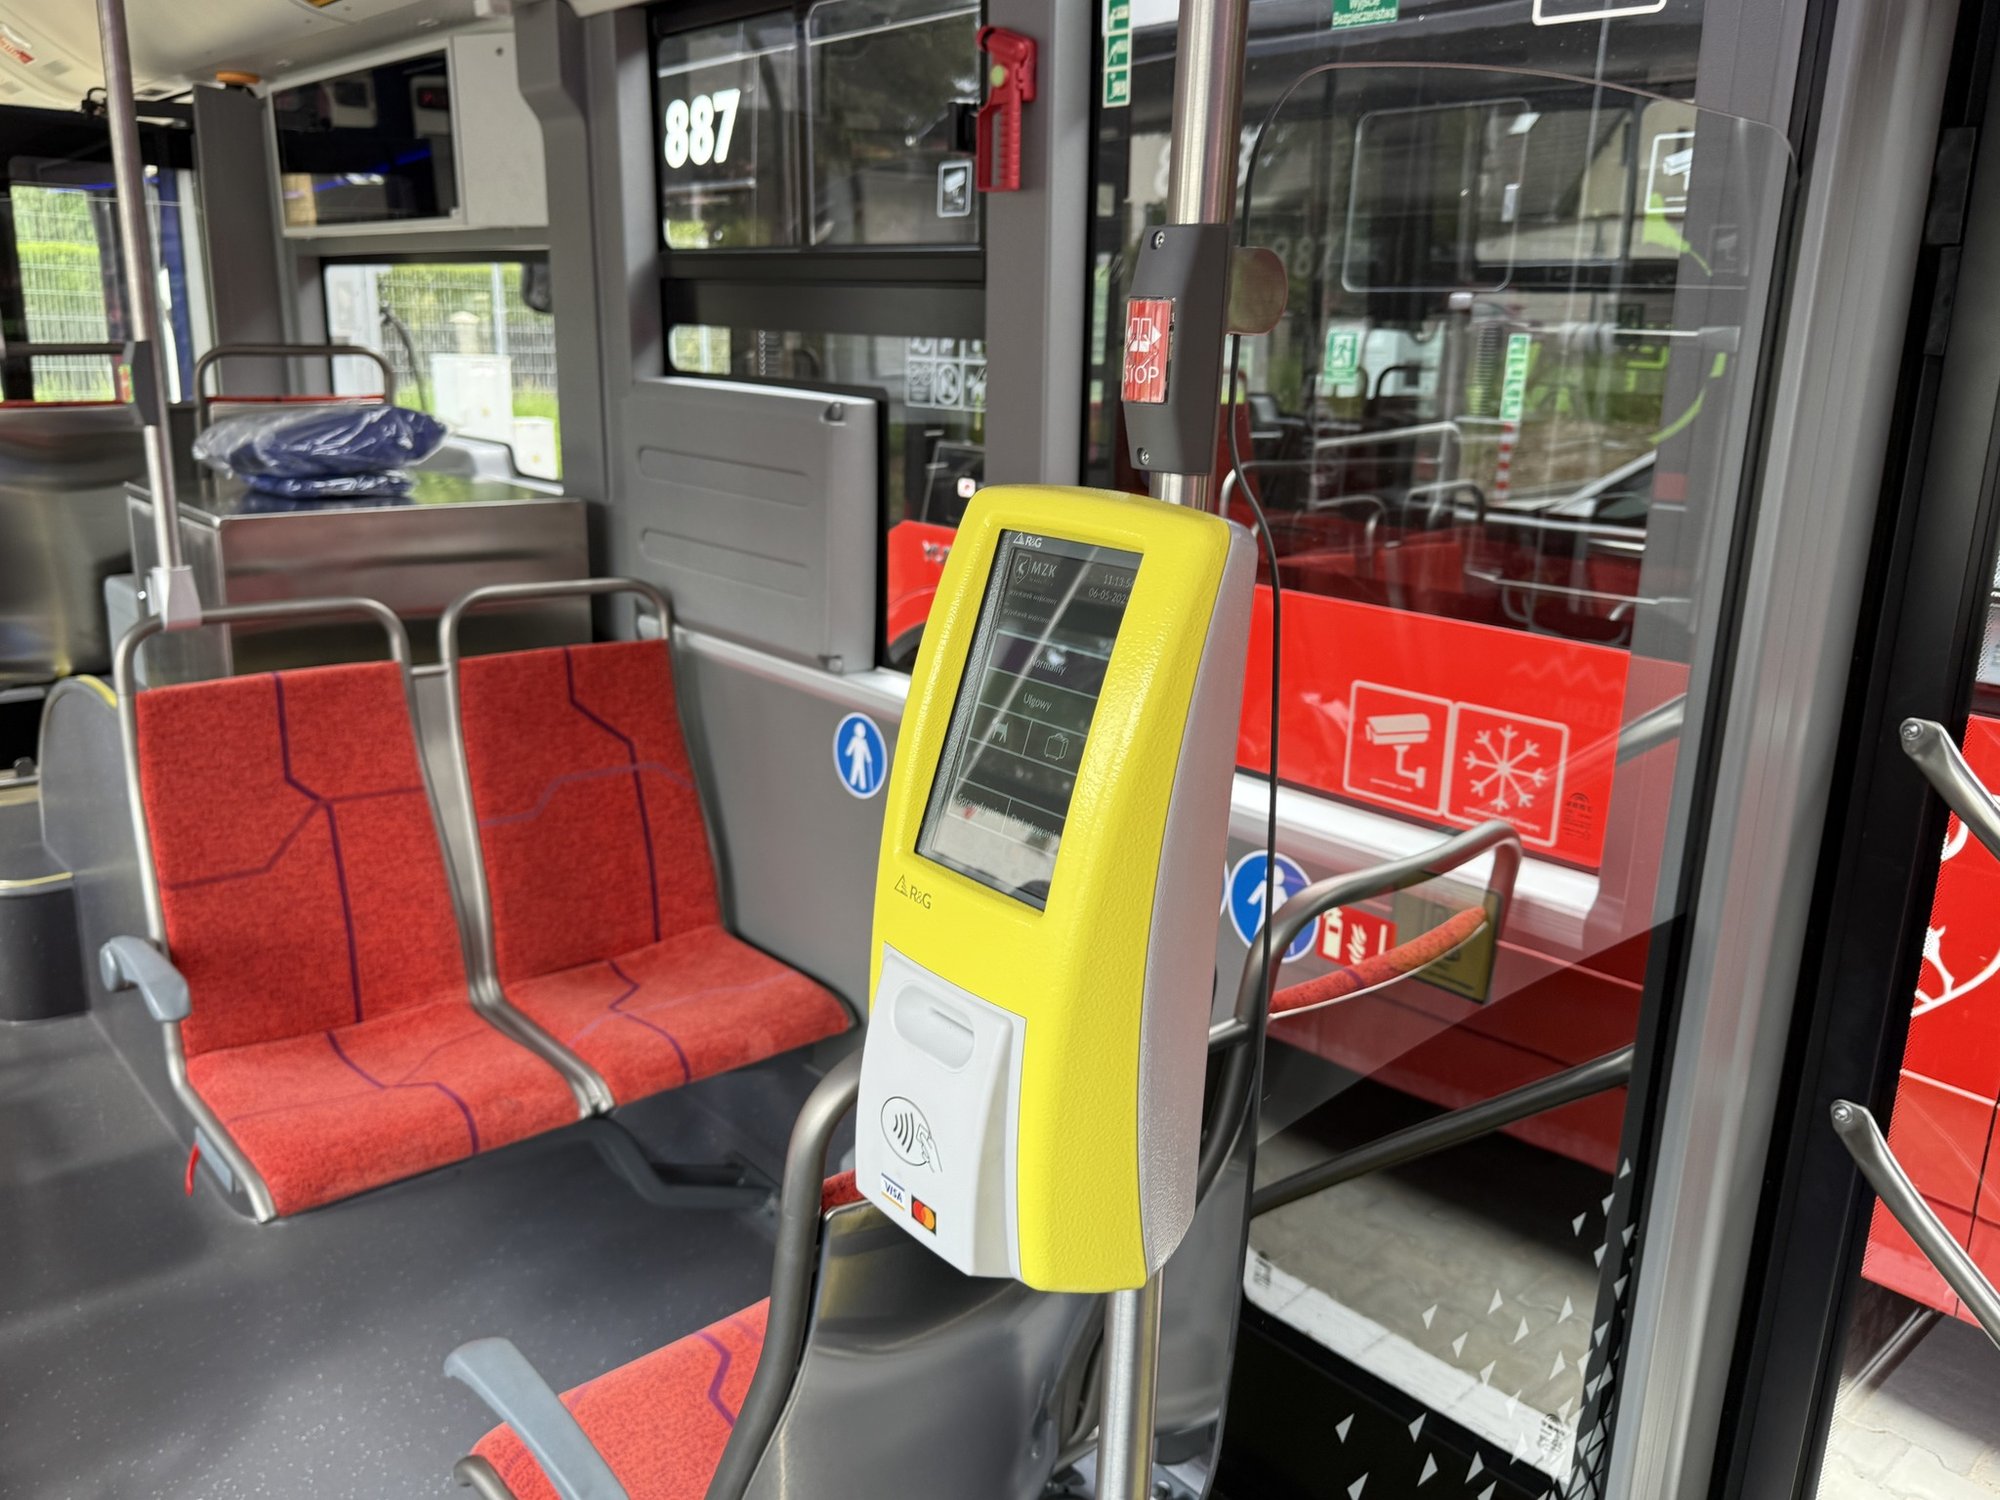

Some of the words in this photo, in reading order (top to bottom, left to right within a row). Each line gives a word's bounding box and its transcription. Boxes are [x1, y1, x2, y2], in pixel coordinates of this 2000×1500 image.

[664, 88, 741, 168] 887
[1124, 363, 1160, 384] STOP
[1030, 562, 1059, 578] MZK
[1103, 573, 1133, 588] 11:13:5
[1088, 587, 1129, 605] 06-05-202
[1023, 692, 1052, 712] Ulgowy
[909, 885, 932, 910] R&G
[883, 1180, 903, 1203] VISA
